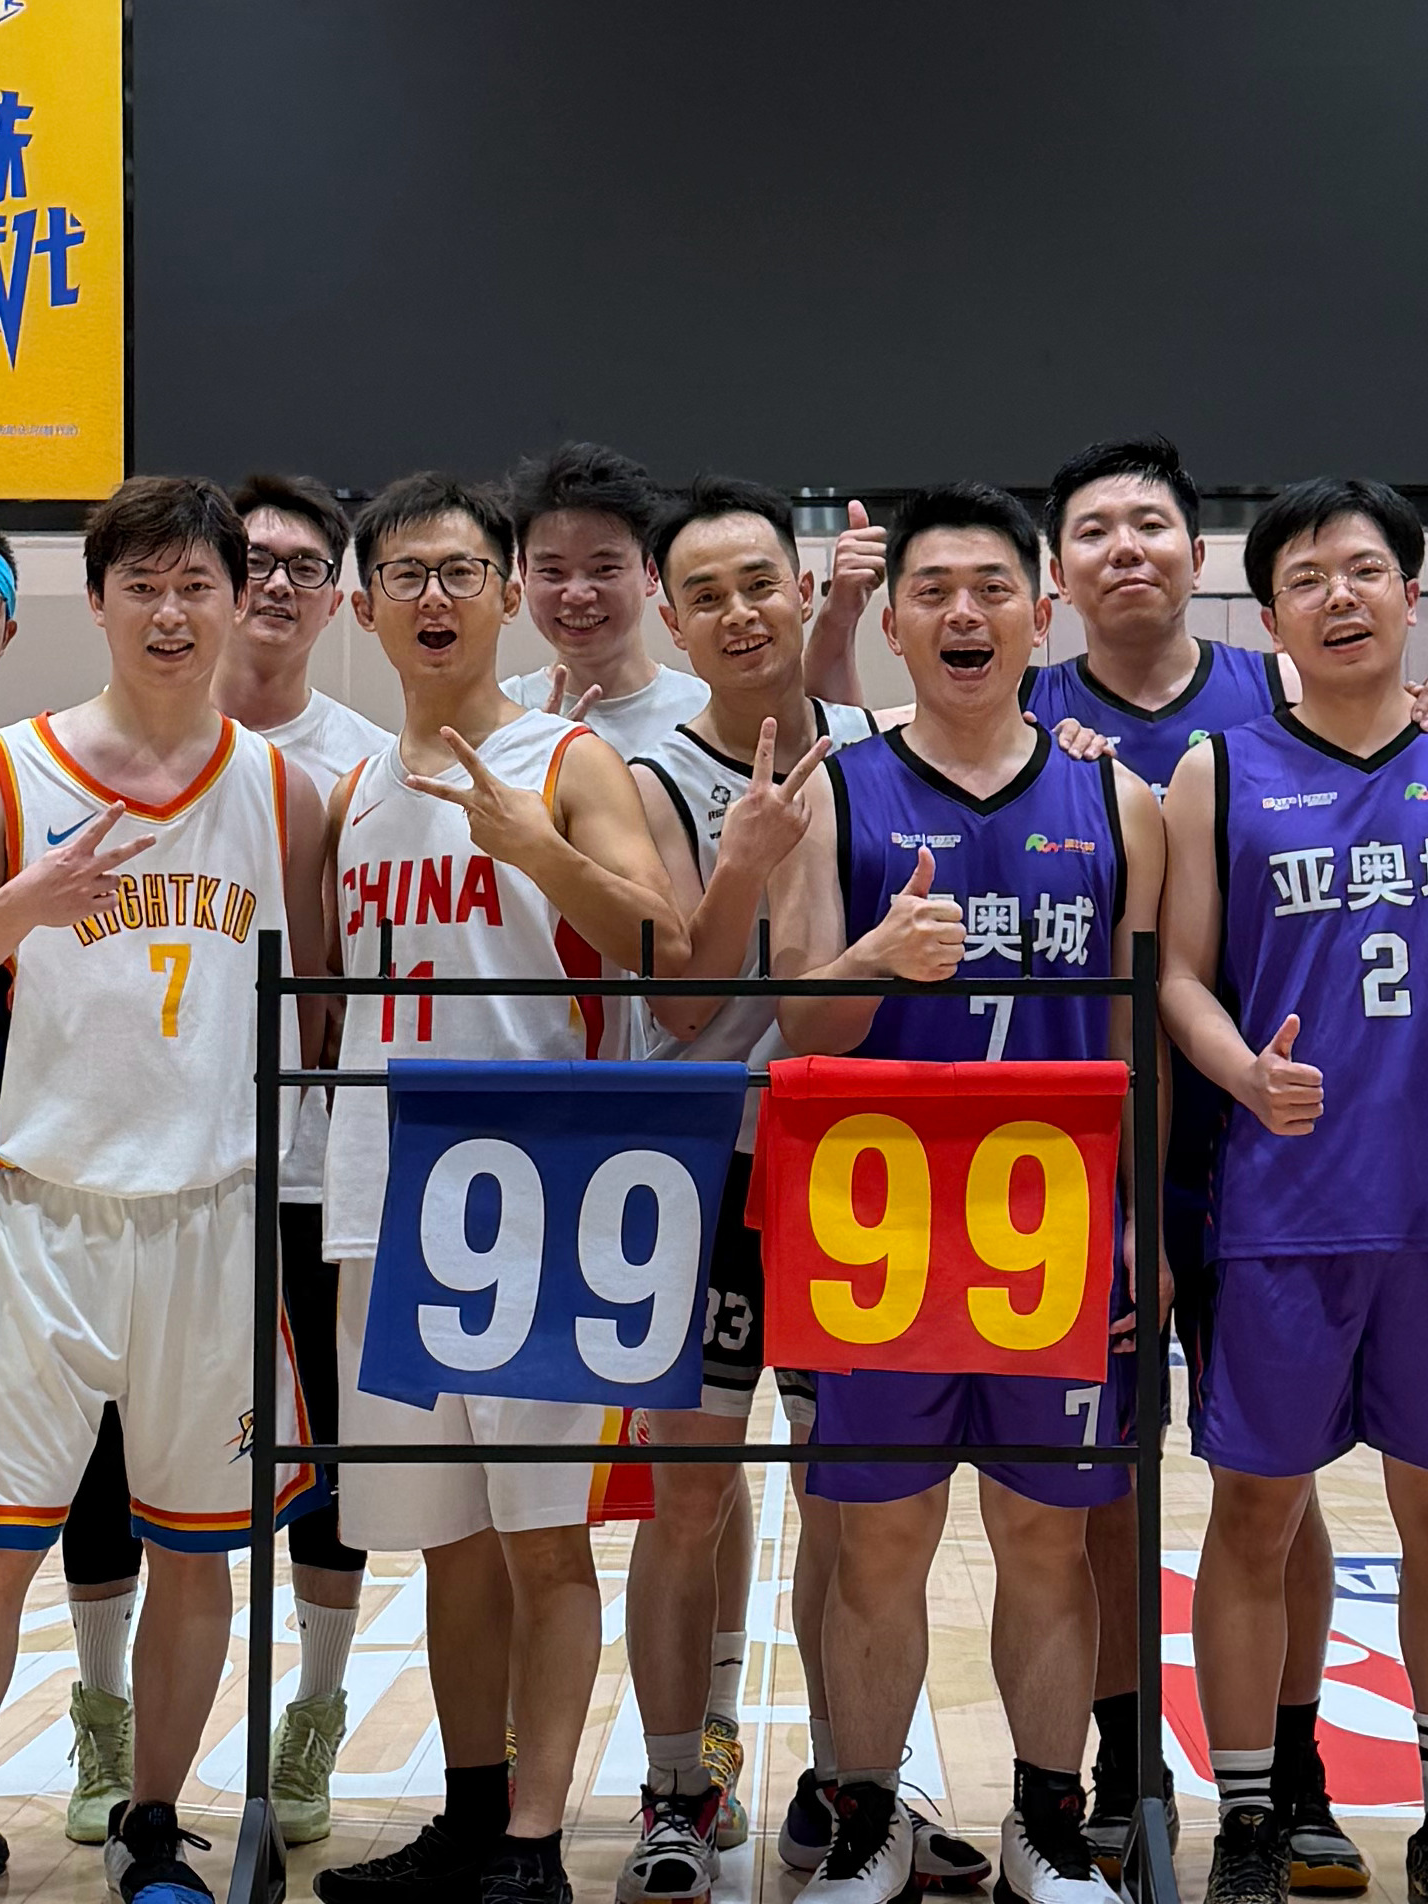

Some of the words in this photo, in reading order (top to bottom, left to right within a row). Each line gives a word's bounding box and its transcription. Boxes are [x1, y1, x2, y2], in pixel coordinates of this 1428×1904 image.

[343, 855, 504, 936] CHINA
[148, 943, 192, 1037] 7
[1360, 932, 1413, 1017] 2
[969, 995, 1014, 1062] 7
[417, 1138, 703, 1384] 99
[808, 1113, 1090, 1351] 99
[1065, 1385, 1102, 1470] 7
